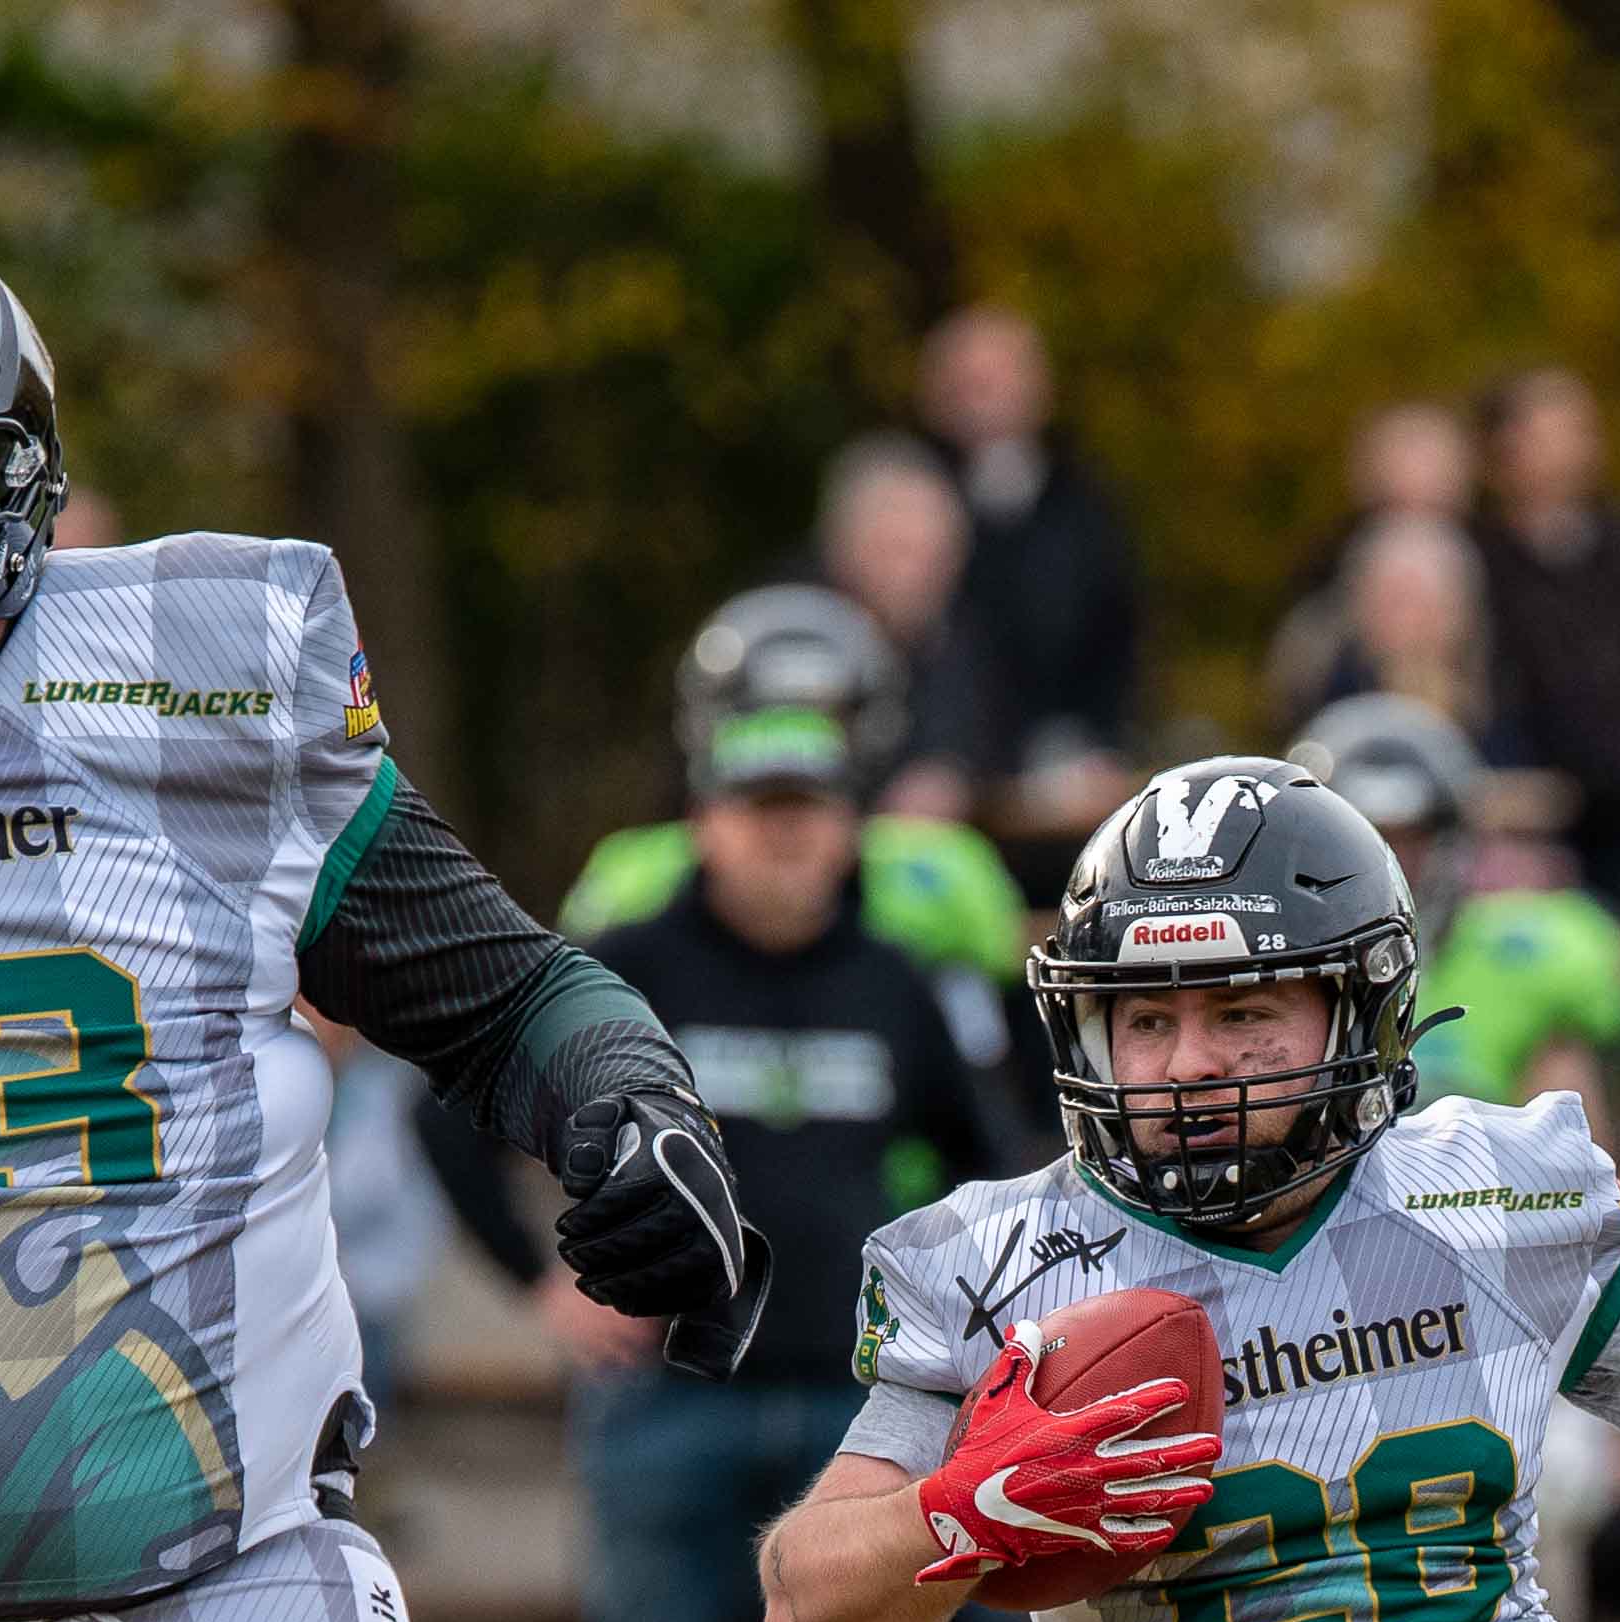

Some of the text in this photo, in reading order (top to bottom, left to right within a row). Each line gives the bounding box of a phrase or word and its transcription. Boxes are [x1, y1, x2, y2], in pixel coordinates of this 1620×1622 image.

[23, 680, 273, 717] LUMBERJACKS
[1133, 920, 1227, 946] Riddell
[1256, 932, 1287, 952] 28
[1404, 1186, 1583, 1211] LUMBERJACKS
[1223, 1303, 1465, 1408] stheimer
